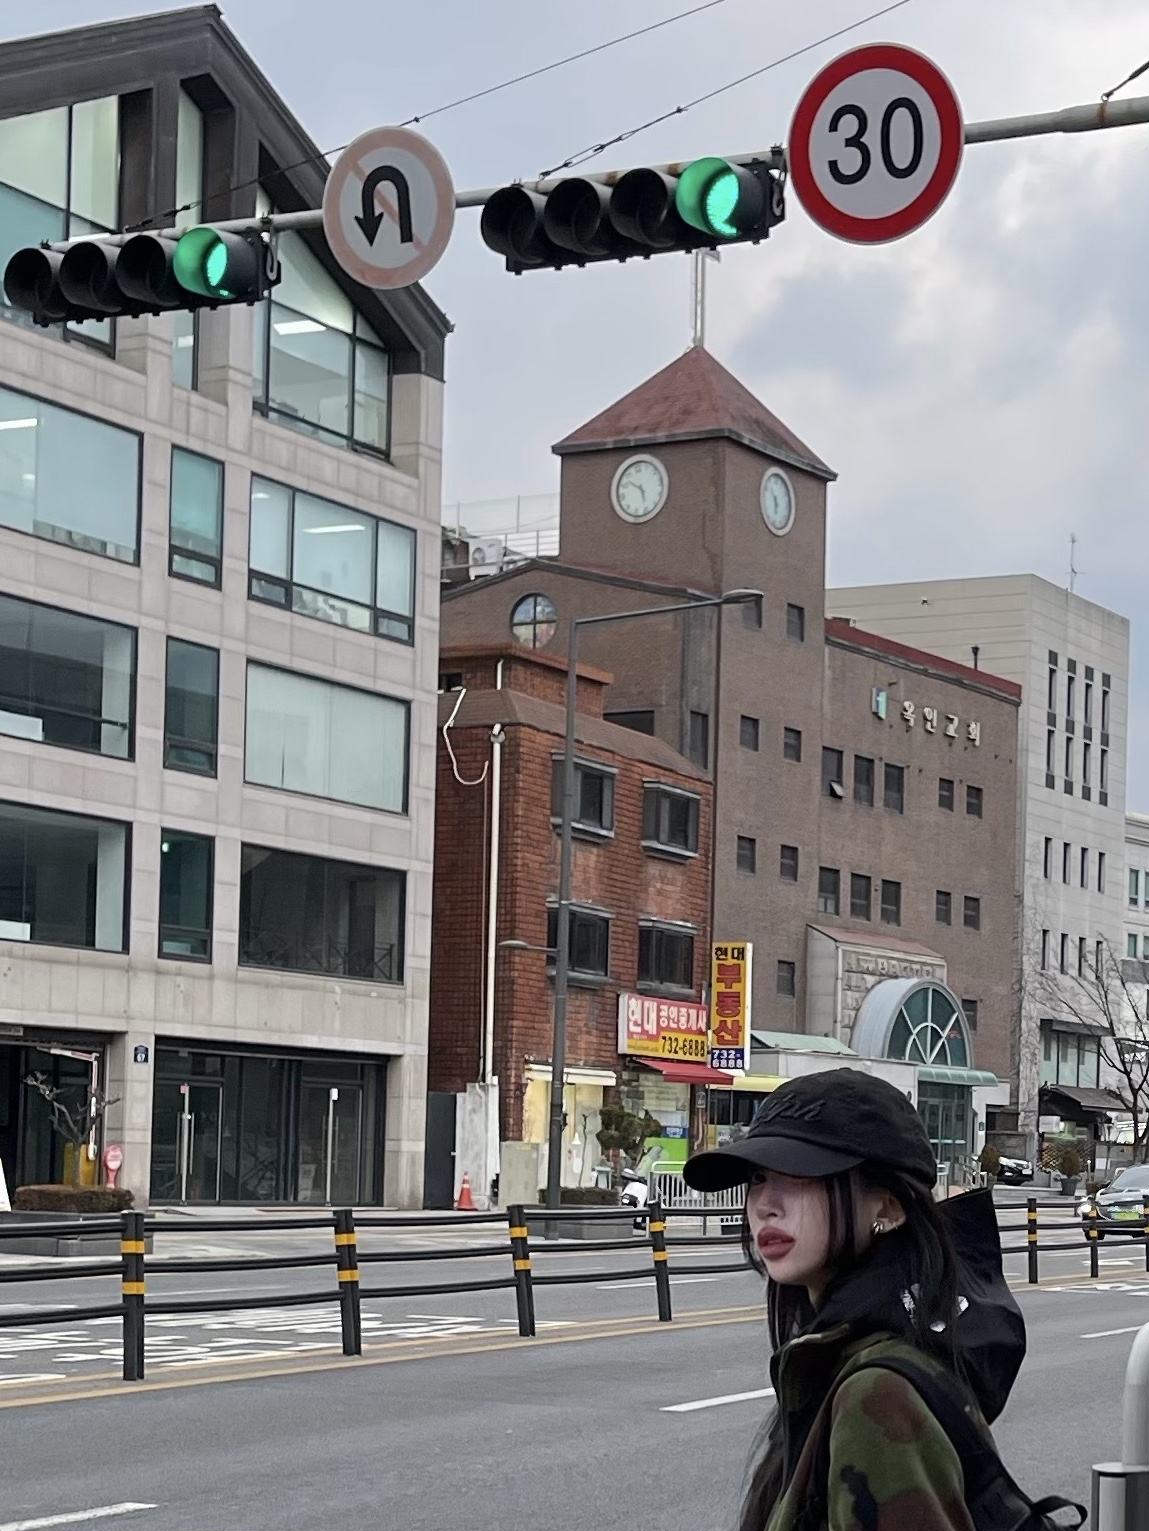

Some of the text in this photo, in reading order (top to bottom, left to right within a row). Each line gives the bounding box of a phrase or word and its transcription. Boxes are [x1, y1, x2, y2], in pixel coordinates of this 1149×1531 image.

[828, 97, 924, 185] 30
[903, 701, 980, 746] 옥인교회
[715, 947, 745, 960] 현대
[628, 997, 707, 1036] 현대 공인중개사
[714, 963, 742, 1046] 부동산
[661, 1035, 706, 1058] 732-6888
[712, 1059, 743, 1068] 6888
